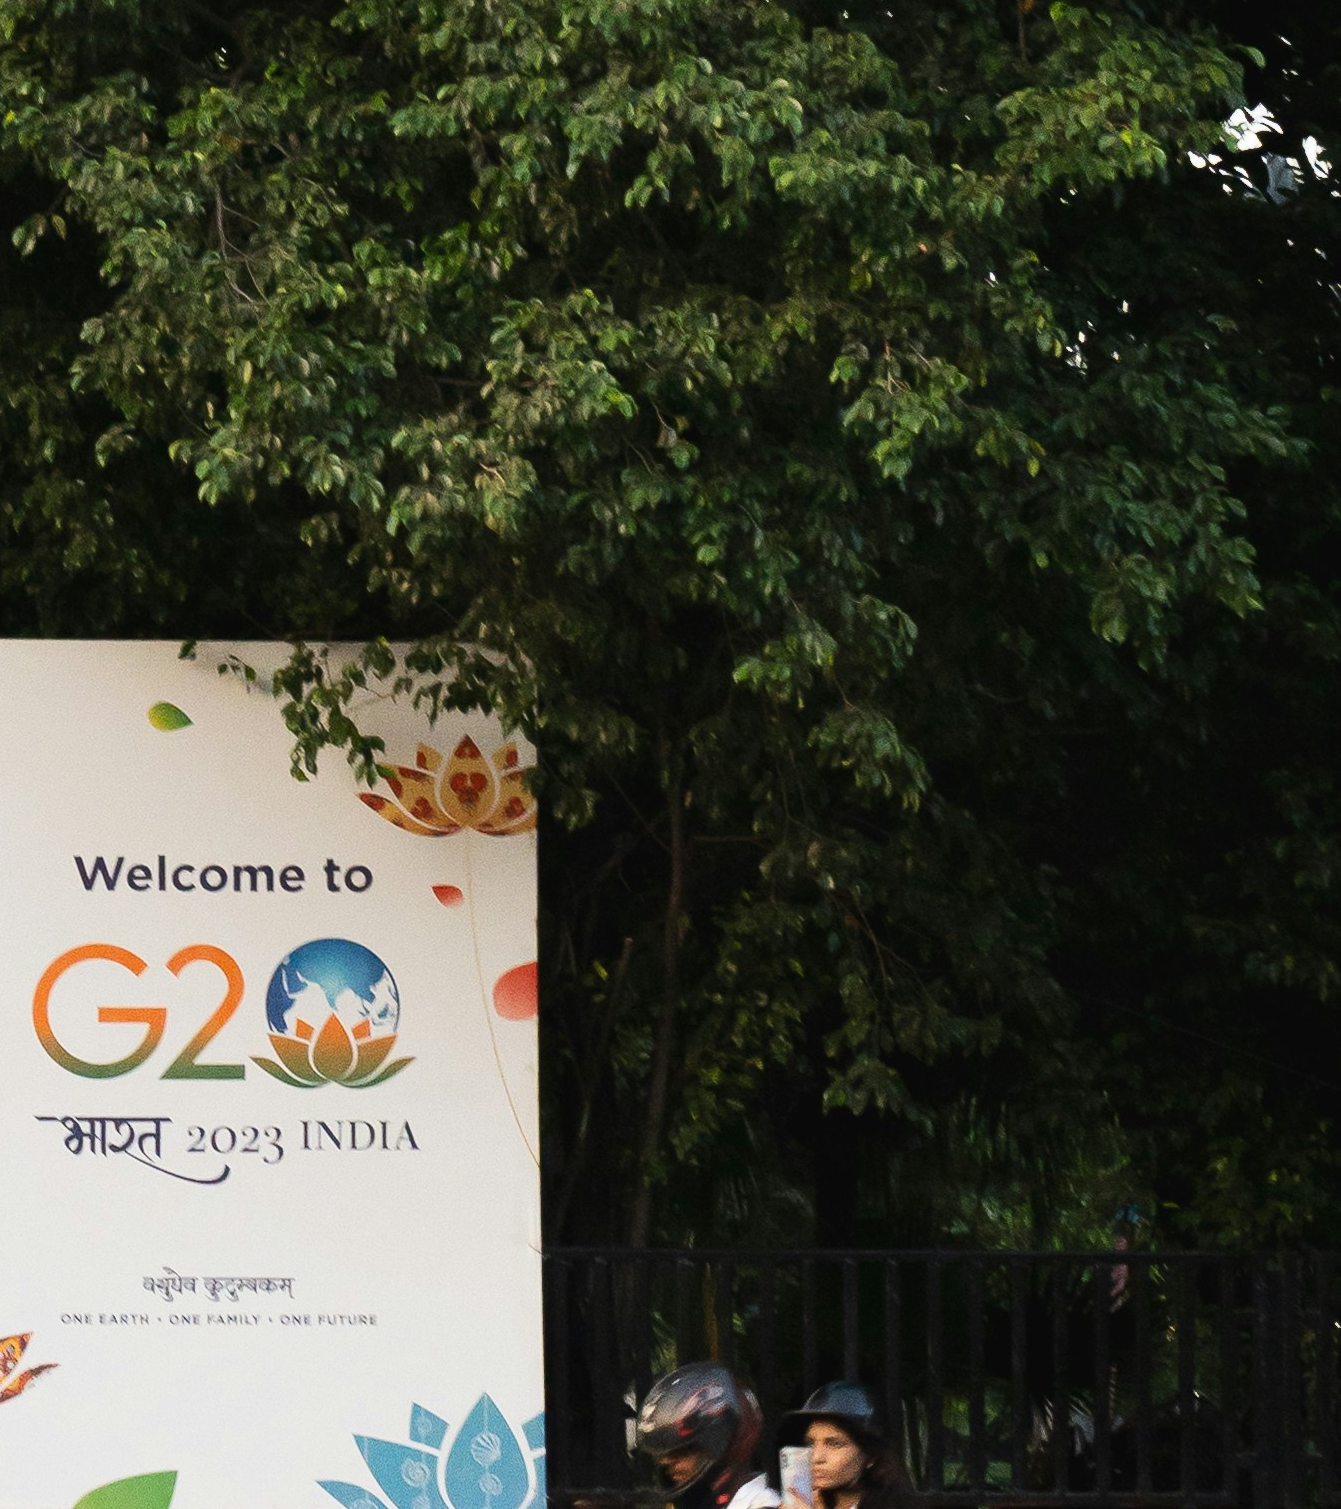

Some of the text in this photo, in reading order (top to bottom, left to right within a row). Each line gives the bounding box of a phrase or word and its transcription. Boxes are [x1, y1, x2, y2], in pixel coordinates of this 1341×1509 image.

[74, 855, 374, 892] Welcome to
[35, 1116, 419, 1184] भारत 2023 INDIA
[60, 1313, 378, 1326] ONE EARTH ONE FAMILY ONE FUTURE
